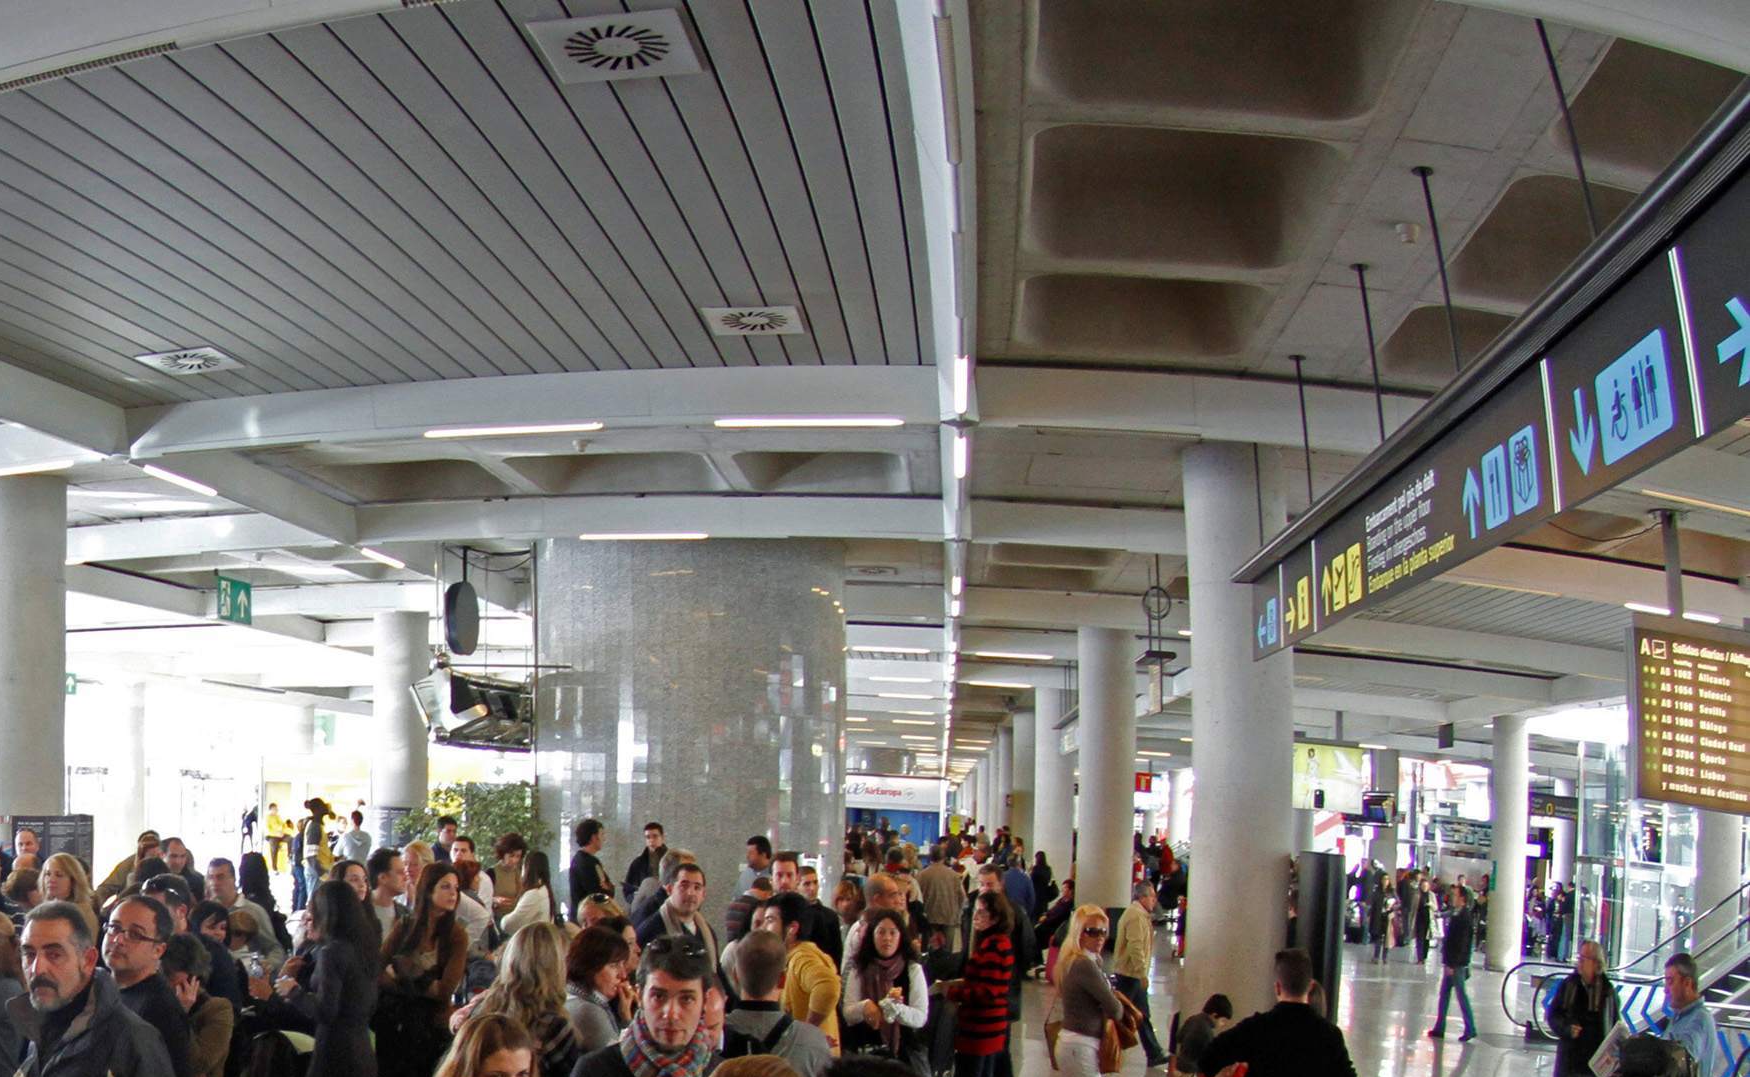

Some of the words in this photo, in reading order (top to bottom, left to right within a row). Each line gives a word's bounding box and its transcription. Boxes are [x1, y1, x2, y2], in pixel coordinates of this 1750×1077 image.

[1640, 638, 1650, 655] A
[1698, 672, 1730, 687] Alicante
[1699, 688, 1732, 702] Valencia
[1699, 704, 1726, 718] Sevilla
[1699, 720, 1727, 734] Málaga
[1700, 736, 1727, 750] Ciudad
[1728, 741, 1746, 753] Real
[1700, 752, 1726, 765] Oporto
[1700, 769, 1726, 782] Lisboa
[1662, 781, 1667, 791] y
[1669, 782, 1697, 794] muchos
[1717, 789, 1748, 802] destinos
